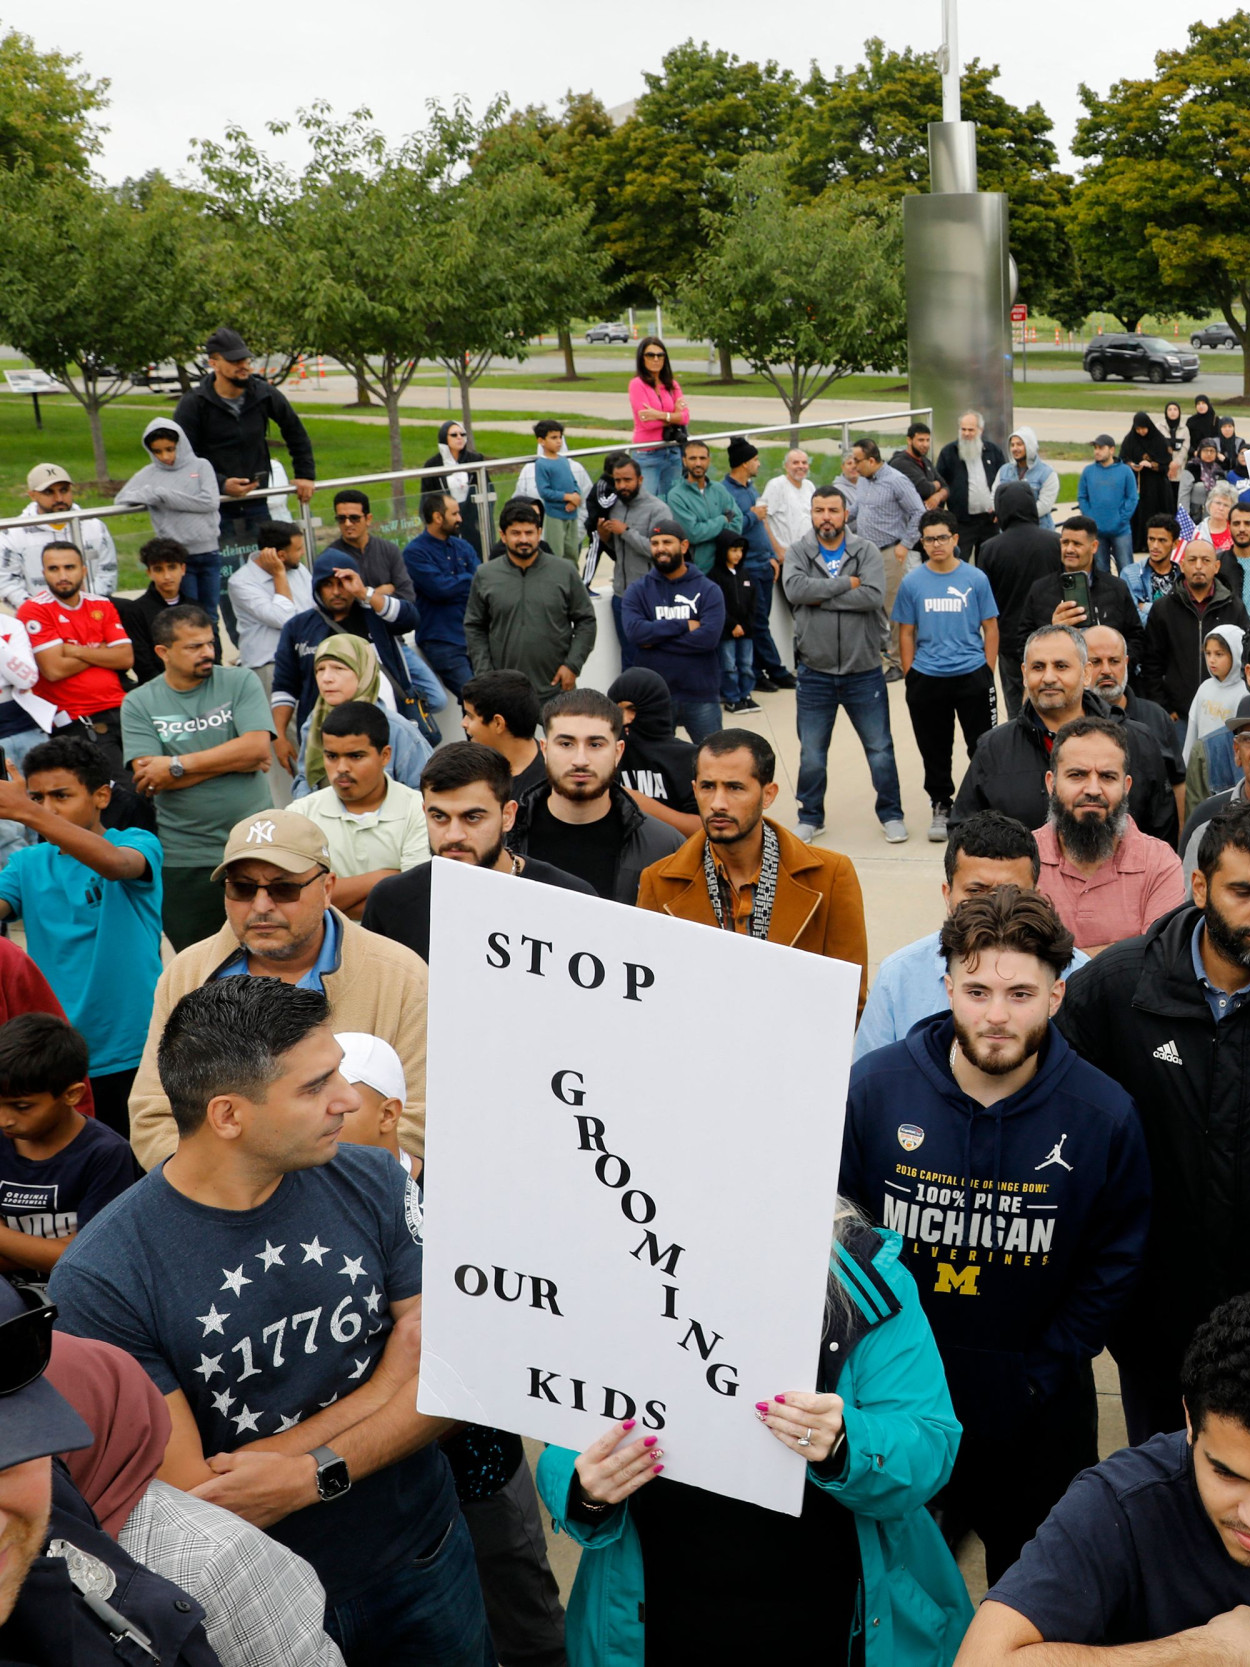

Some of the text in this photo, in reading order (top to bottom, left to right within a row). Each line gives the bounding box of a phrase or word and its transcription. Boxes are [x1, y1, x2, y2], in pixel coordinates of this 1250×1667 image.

[655, 605, 691, 620] PUMA
[924, 598, 962, 613] PUMA
[152, 709, 234, 738] Reebok
[486, 932, 655, 1002] STOP
[1152, 1050, 1184, 1066] adidas
[895, 1163, 918, 1179] 2016
[919, 1169, 959, 1187] CAPITAL
[6, 1191, 49, 1200] ORIGINAL
[915, 1184, 966, 1209] 100%
[551, 1069, 740, 1397] GROOMING
[882, 1192, 1056, 1254] MICHIGAN
[454, 1264, 564, 1317] OUR
[231, 1295, 362, 1382] 1776
[527, 1367, 666, 1431] KIDS
